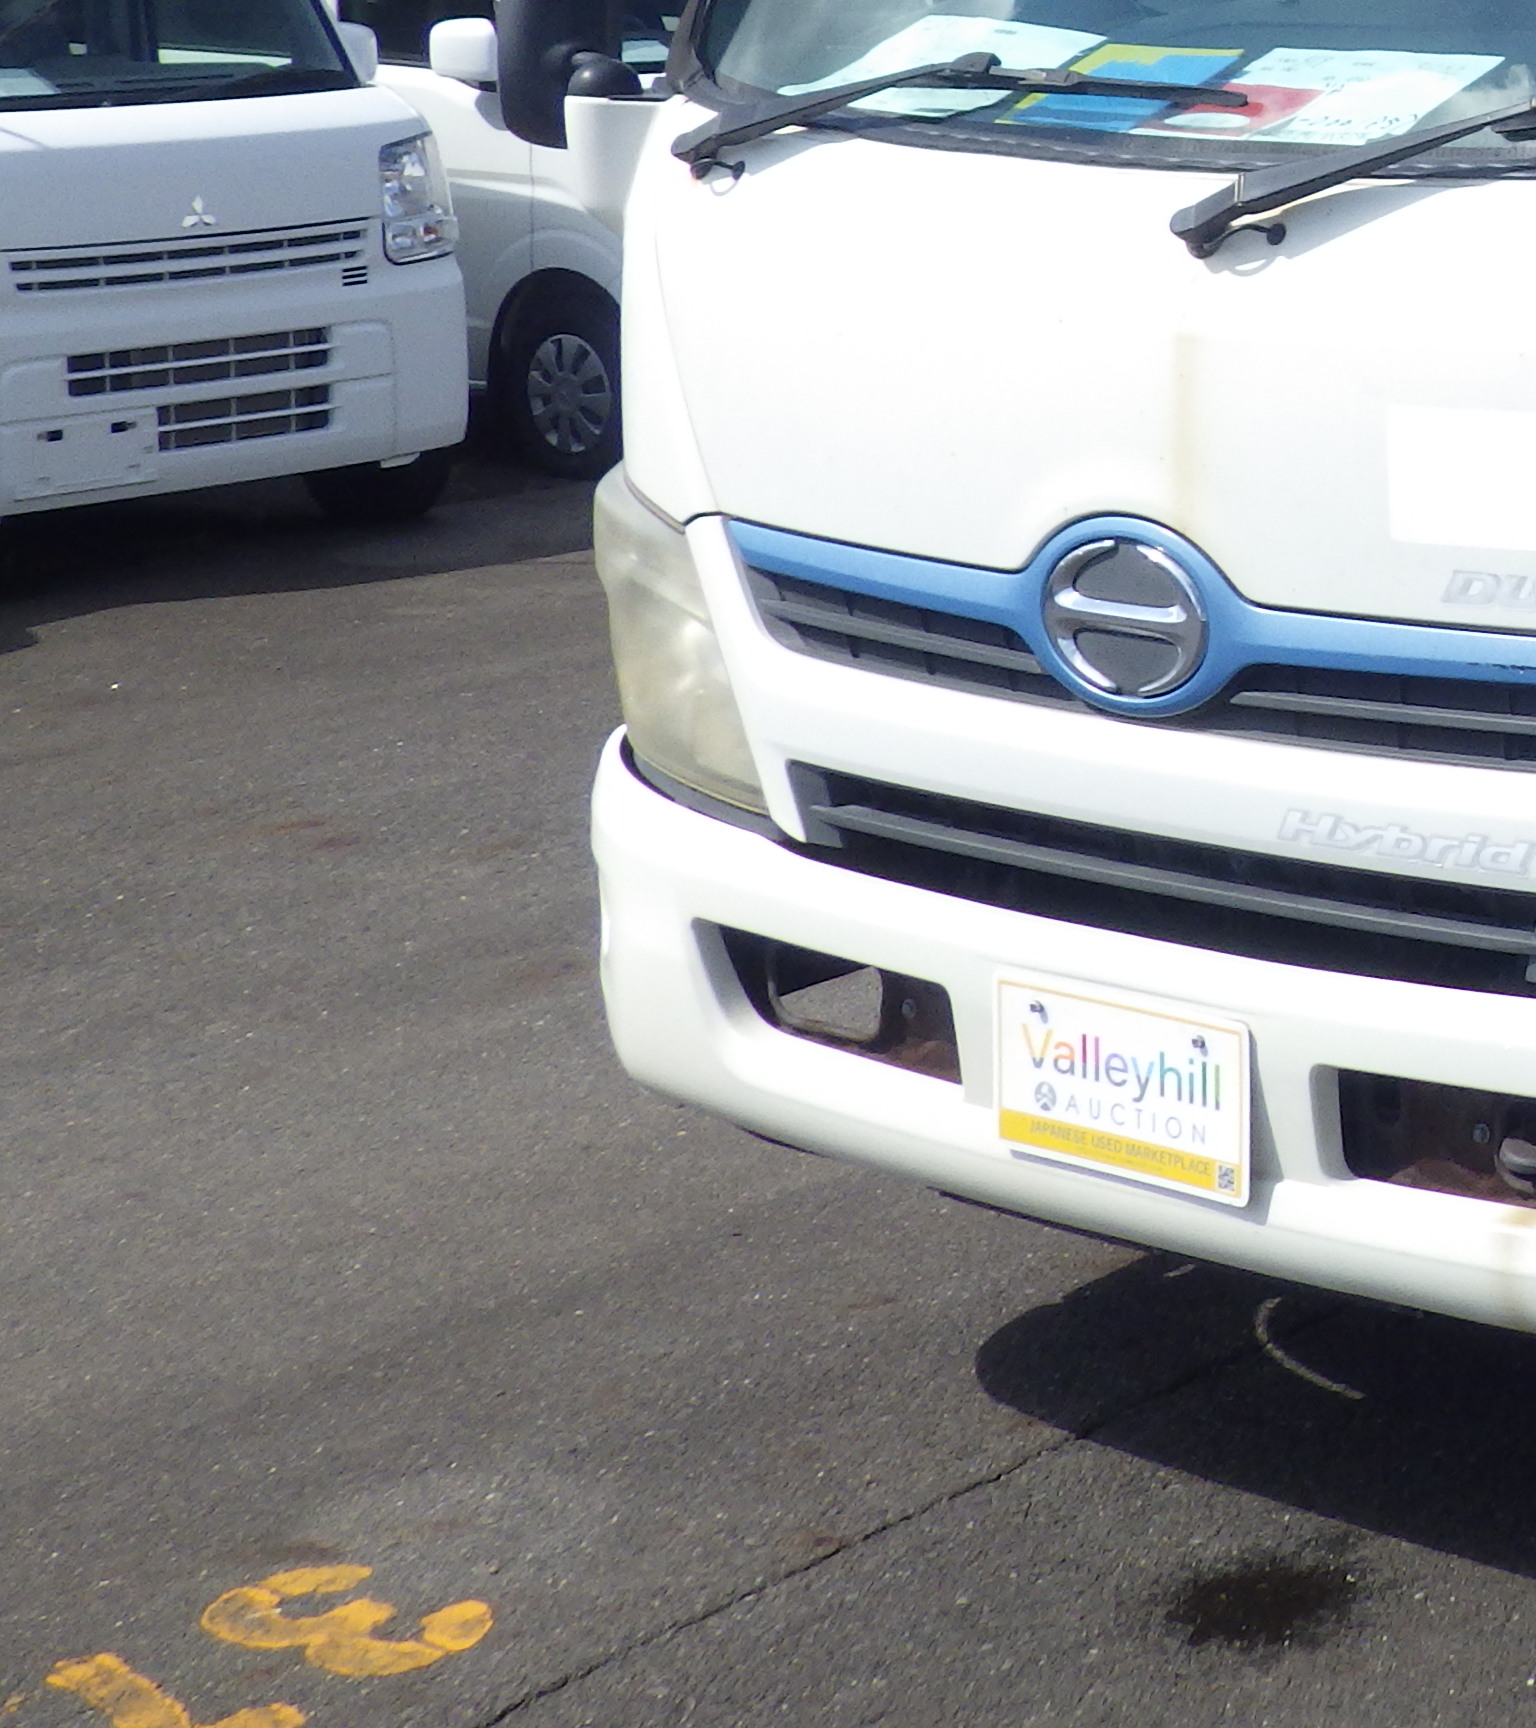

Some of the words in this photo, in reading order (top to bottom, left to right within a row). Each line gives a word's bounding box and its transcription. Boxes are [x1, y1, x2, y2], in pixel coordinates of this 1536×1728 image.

[1022, 1023, 1220, 1111] Valleyhill
[1065, 1094, 1206, 1144] AUCTION
[1030, 1120, 1087, 1145] JAPANESE
[1092, 1136, 1122, 1154] USED
[1124, 1143, 1211, 1176] MARKETPLACE
